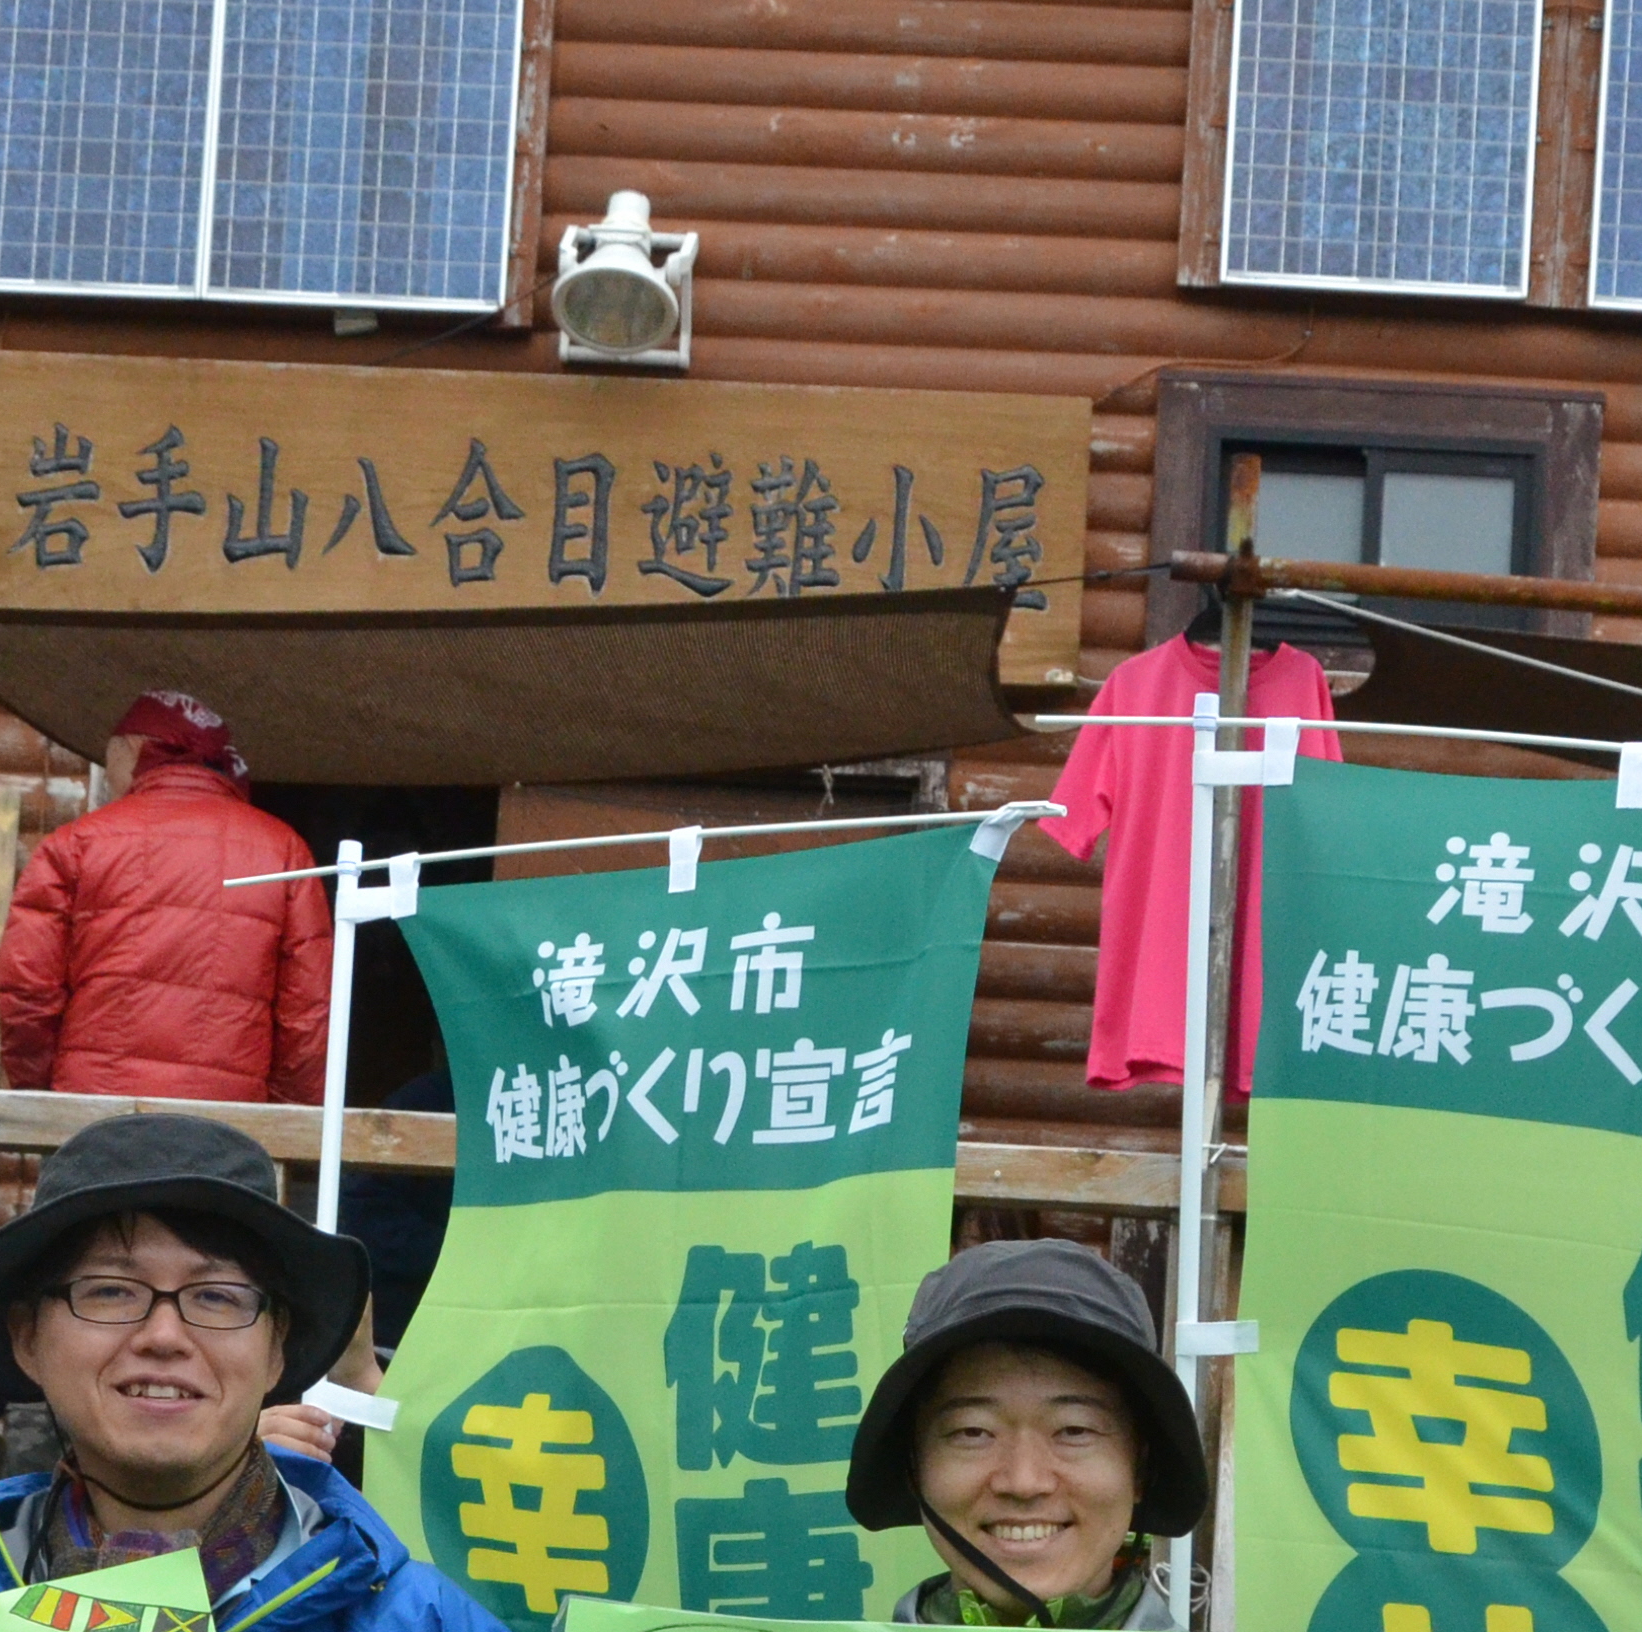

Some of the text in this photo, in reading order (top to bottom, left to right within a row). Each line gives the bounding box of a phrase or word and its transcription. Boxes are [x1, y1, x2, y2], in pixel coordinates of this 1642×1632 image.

[6, 422, 1048, 612] 岩手山八合目避難小屋
[532, 911, 815, 1028] 滝沢市
[485, 1027, 912, 1163] 健康づくり宣言
